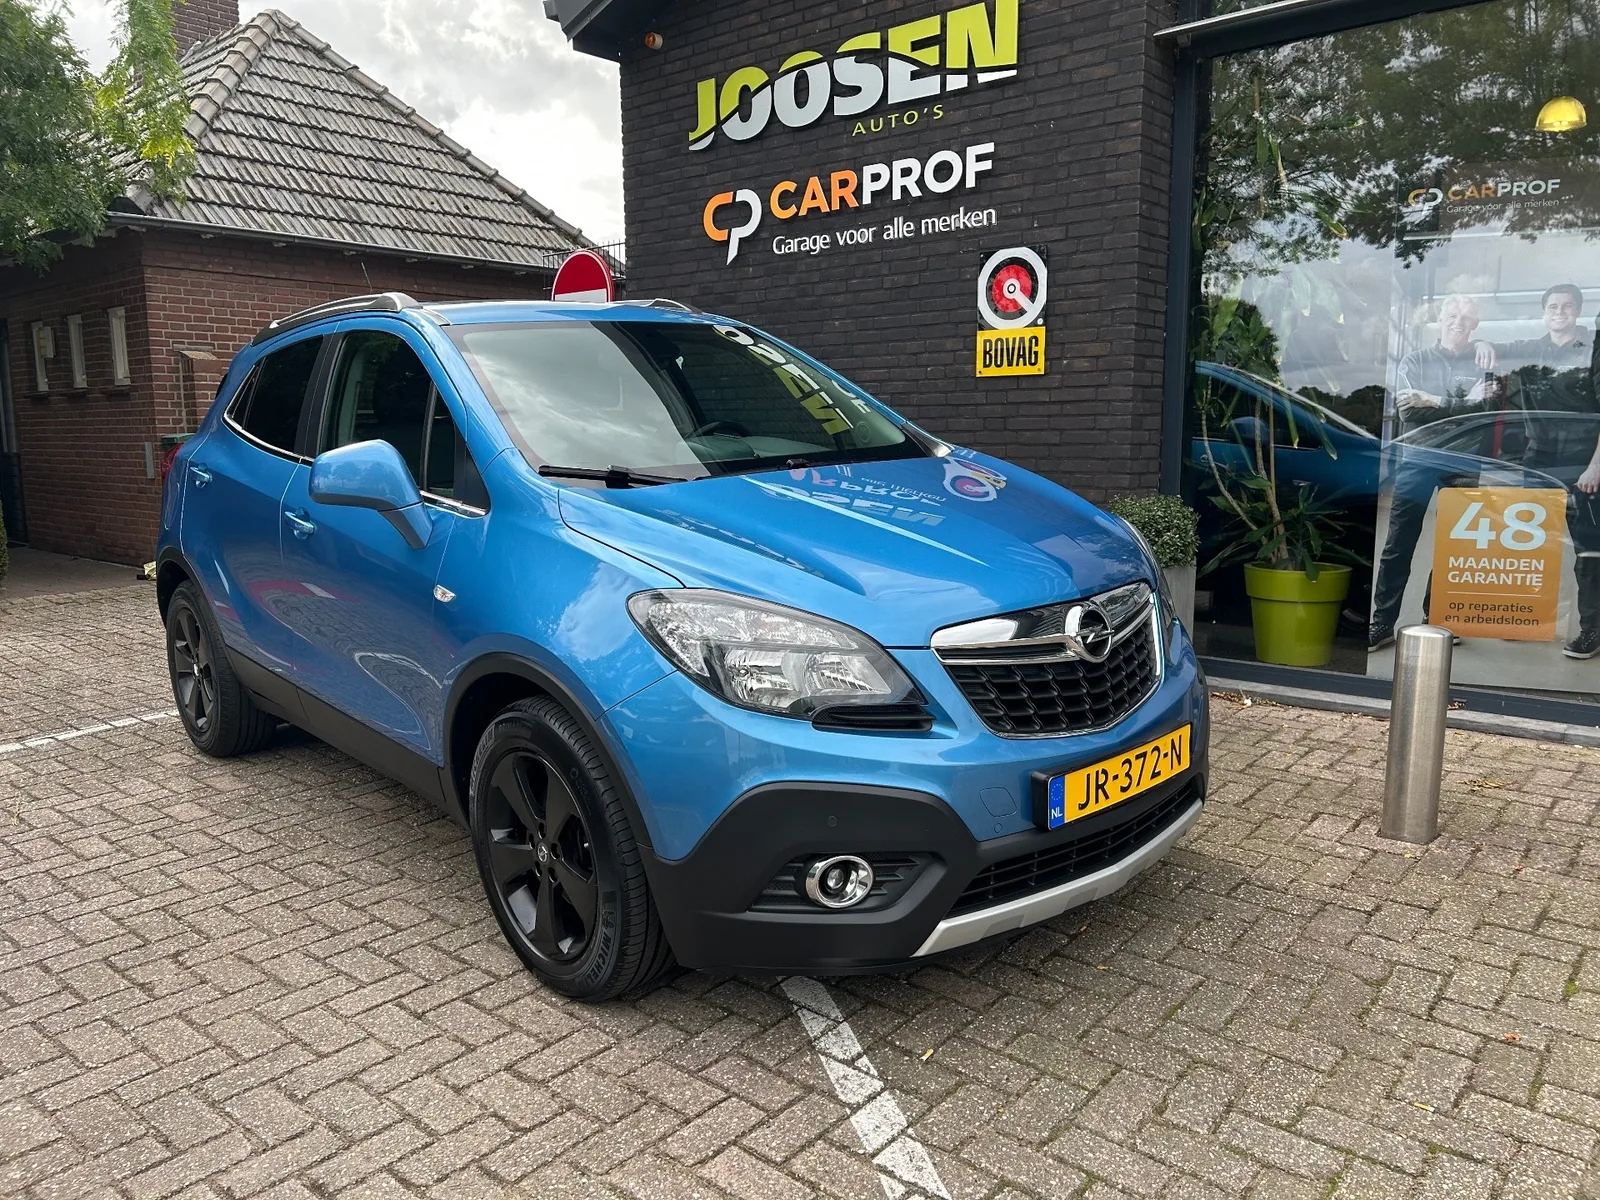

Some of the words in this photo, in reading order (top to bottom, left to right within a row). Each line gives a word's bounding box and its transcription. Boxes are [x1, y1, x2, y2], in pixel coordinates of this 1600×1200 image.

[689, 0, 1018, 151] JOOSEN
[851, 104, 944, 137] AUTO'S
[769, 141, 995, 220] CARPROF
[1448, 178, 1561, 201] CARPROF
[1446, 204, 1480, 214] Garage
[1506, 199, 1521, 210] alle
[1524, 198, 1560, 209] merken
[772, 234, 831, 255] Garage
[836, 226, 878, 247] voor
[883, 216, 914, 240] alle
[921, 206, 997, 236] merken
[982, 335, 1039, 369] BOVAG
[1449, 501, 1547, 551] 48
[1447, 571, 1543, 586] GARANTIE
[1448, 556, 1545, 571] MAANDEN
[1444, 614, 1460, 623] en
[1463, 613, 1540, 626] arbeidsloon
[1449, 601, 1465, 612] op
[1468, 602, 1534, 614] reparaties
[1051, 806, 1063, 820] NL
[1077, 734, 1182, 811] JR-372-N
